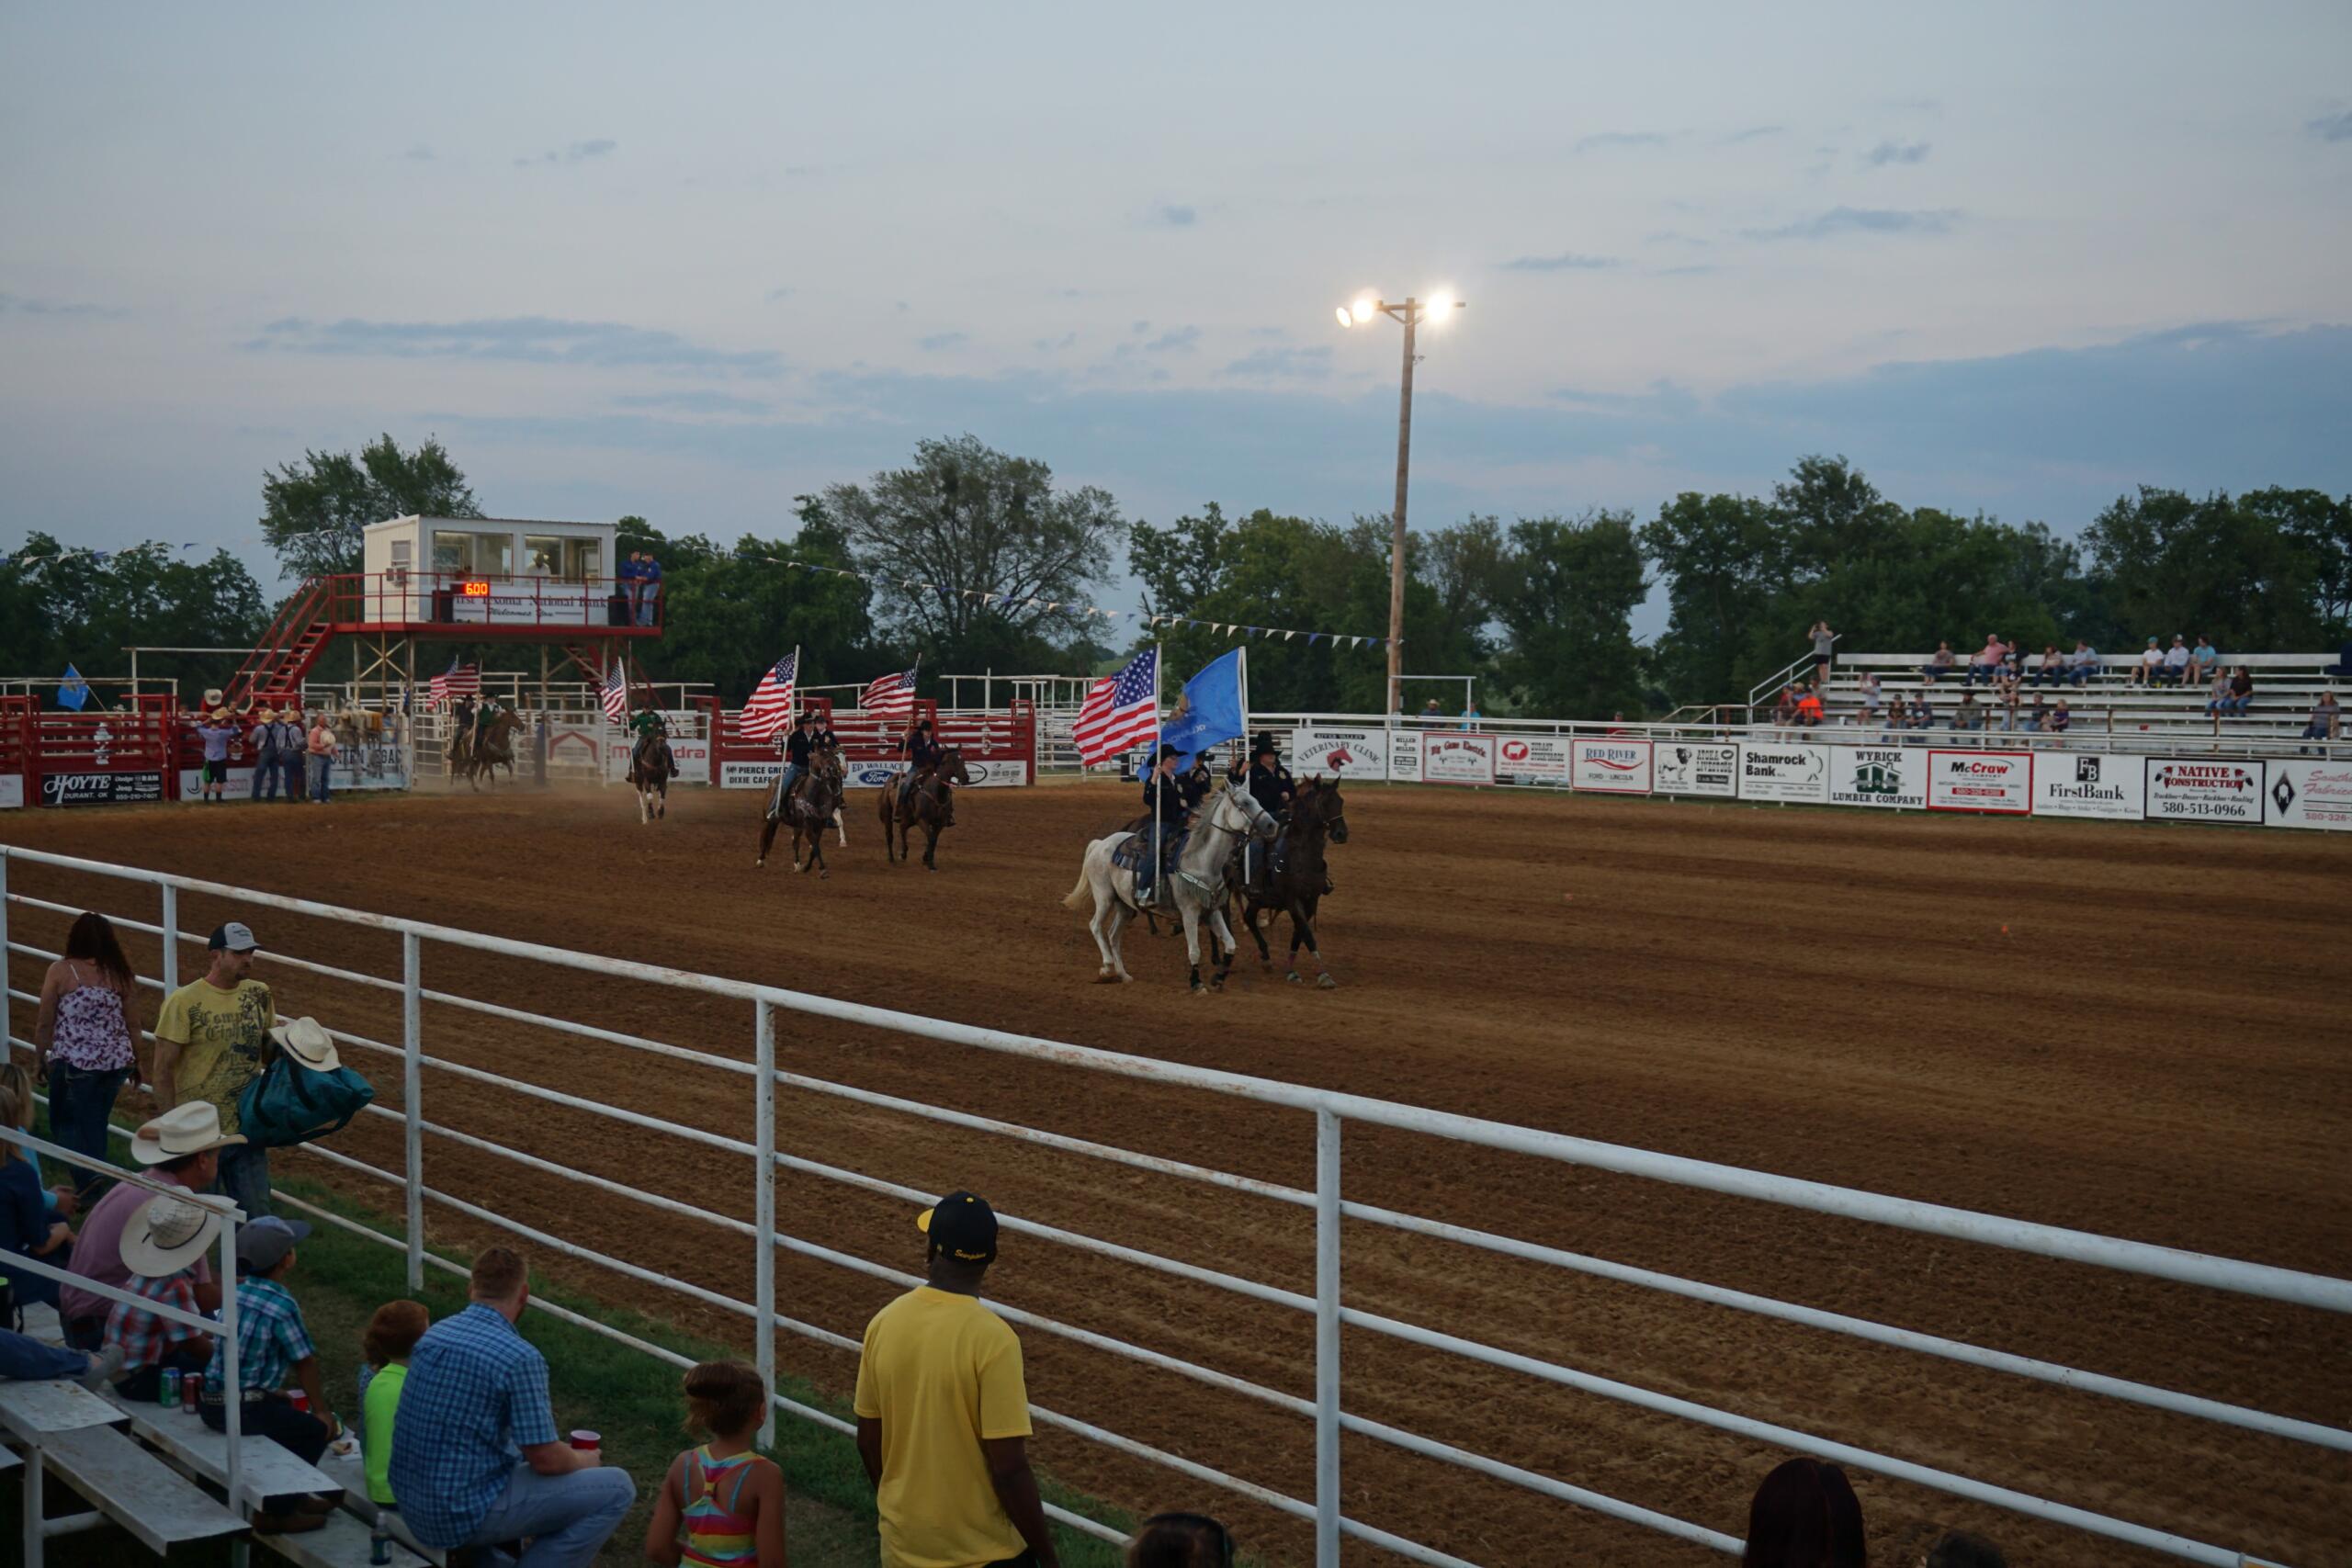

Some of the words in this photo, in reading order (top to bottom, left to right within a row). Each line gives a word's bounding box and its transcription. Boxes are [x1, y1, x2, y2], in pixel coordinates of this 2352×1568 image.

[1298, 741, 1350, 761] VETERINARY
[1353, 743, 1382, 764] CLINIC
[1586, 748, 1605, 759] RED
[1608, 749, 1636, 760] RIVER
[1747, 751, 1806, 765] Shamrock
[1856, 750, 1903, 761] WYRICK
[739, 766, 765, 774] PIERCE
[852, 763, 864, 773] ED
[1746, 764, 1776, 777] Bank
[1951, 761, 2009, 773] McCraw
[2177, 766, 2230, 778] NATIVE
[865, 772, 890, 783] Ford
[44, 774, 111, 804] HOYTE
[2049, 784, 2125, 800] FirstBank
[1832, 792, 1871, 802] LUMBER
[1876, 795, 1923, 805] COMPANY
[2162, 802, 2246, 817] 580-513-0966
